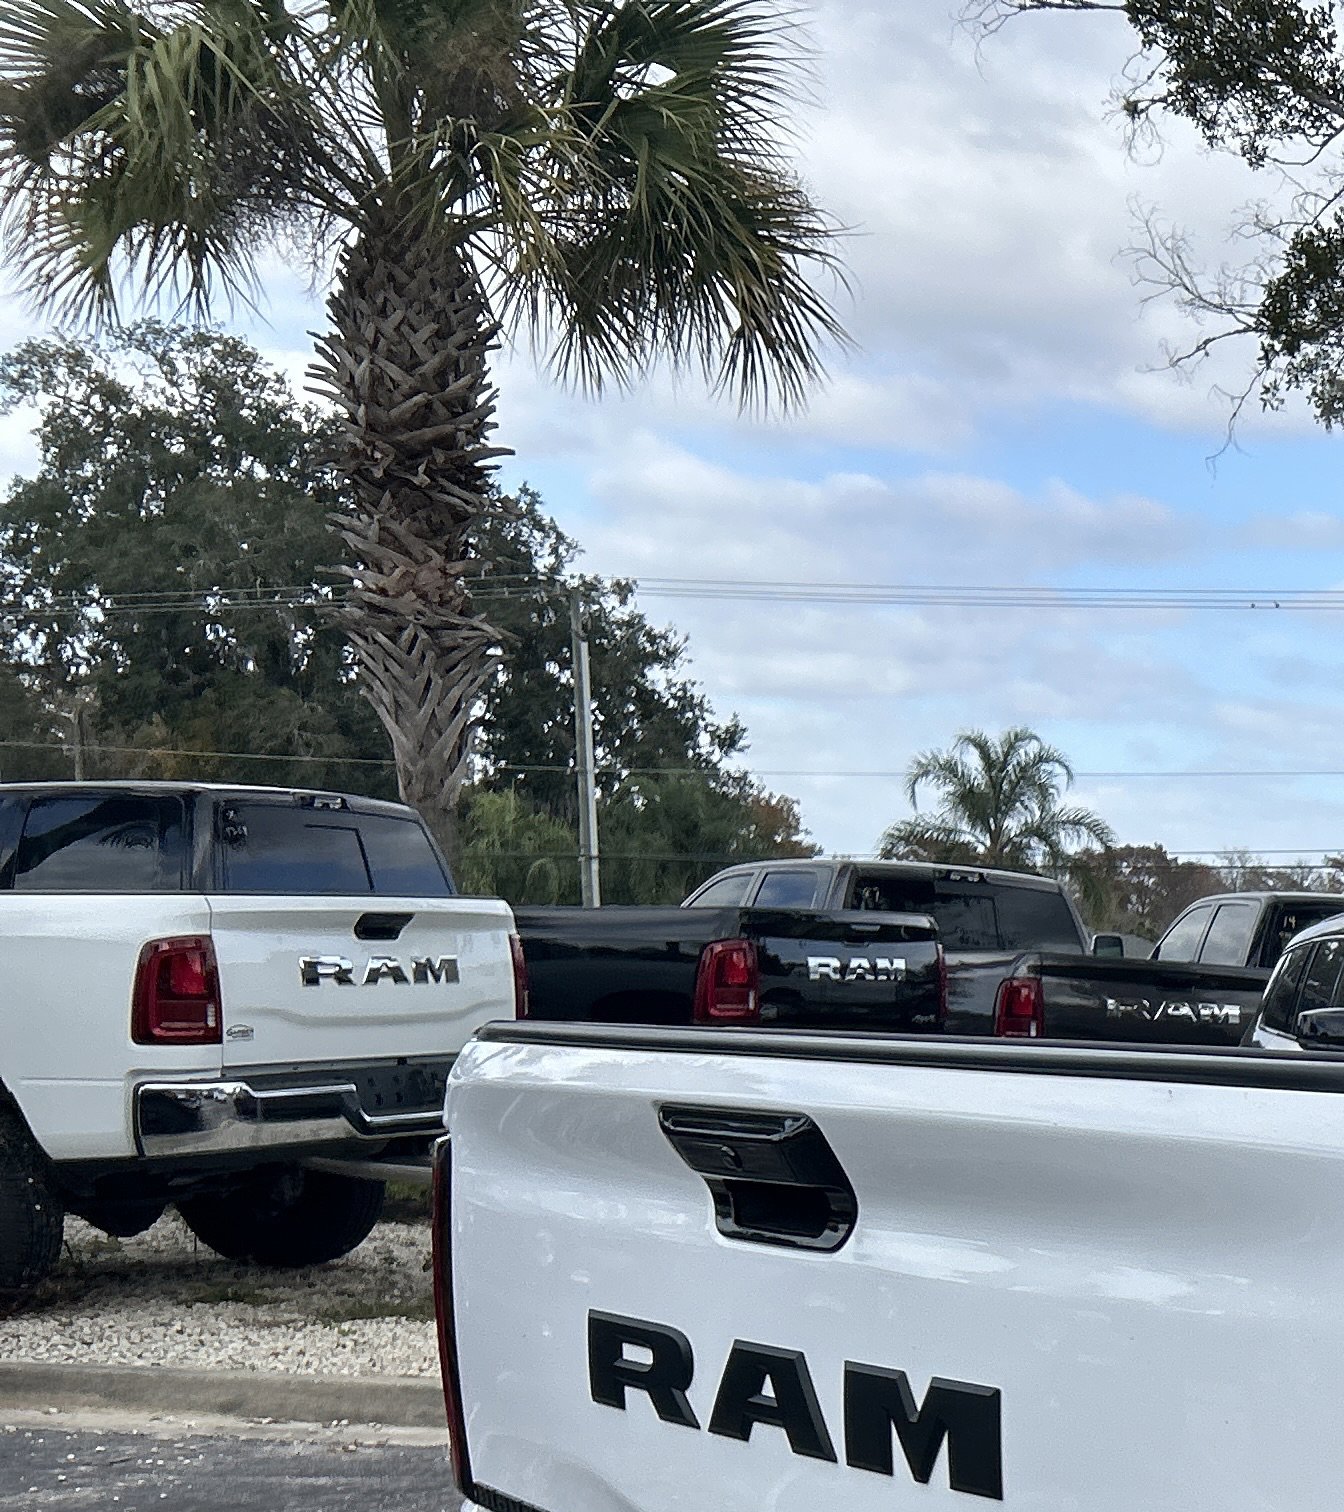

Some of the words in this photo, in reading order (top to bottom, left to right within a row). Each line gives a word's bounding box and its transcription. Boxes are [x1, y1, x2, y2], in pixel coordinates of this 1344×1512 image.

[298, 954, 461, 987] RAM
[806, 956, 907, 982] RAM
[586, 1308, 1004, 1501] RAM
